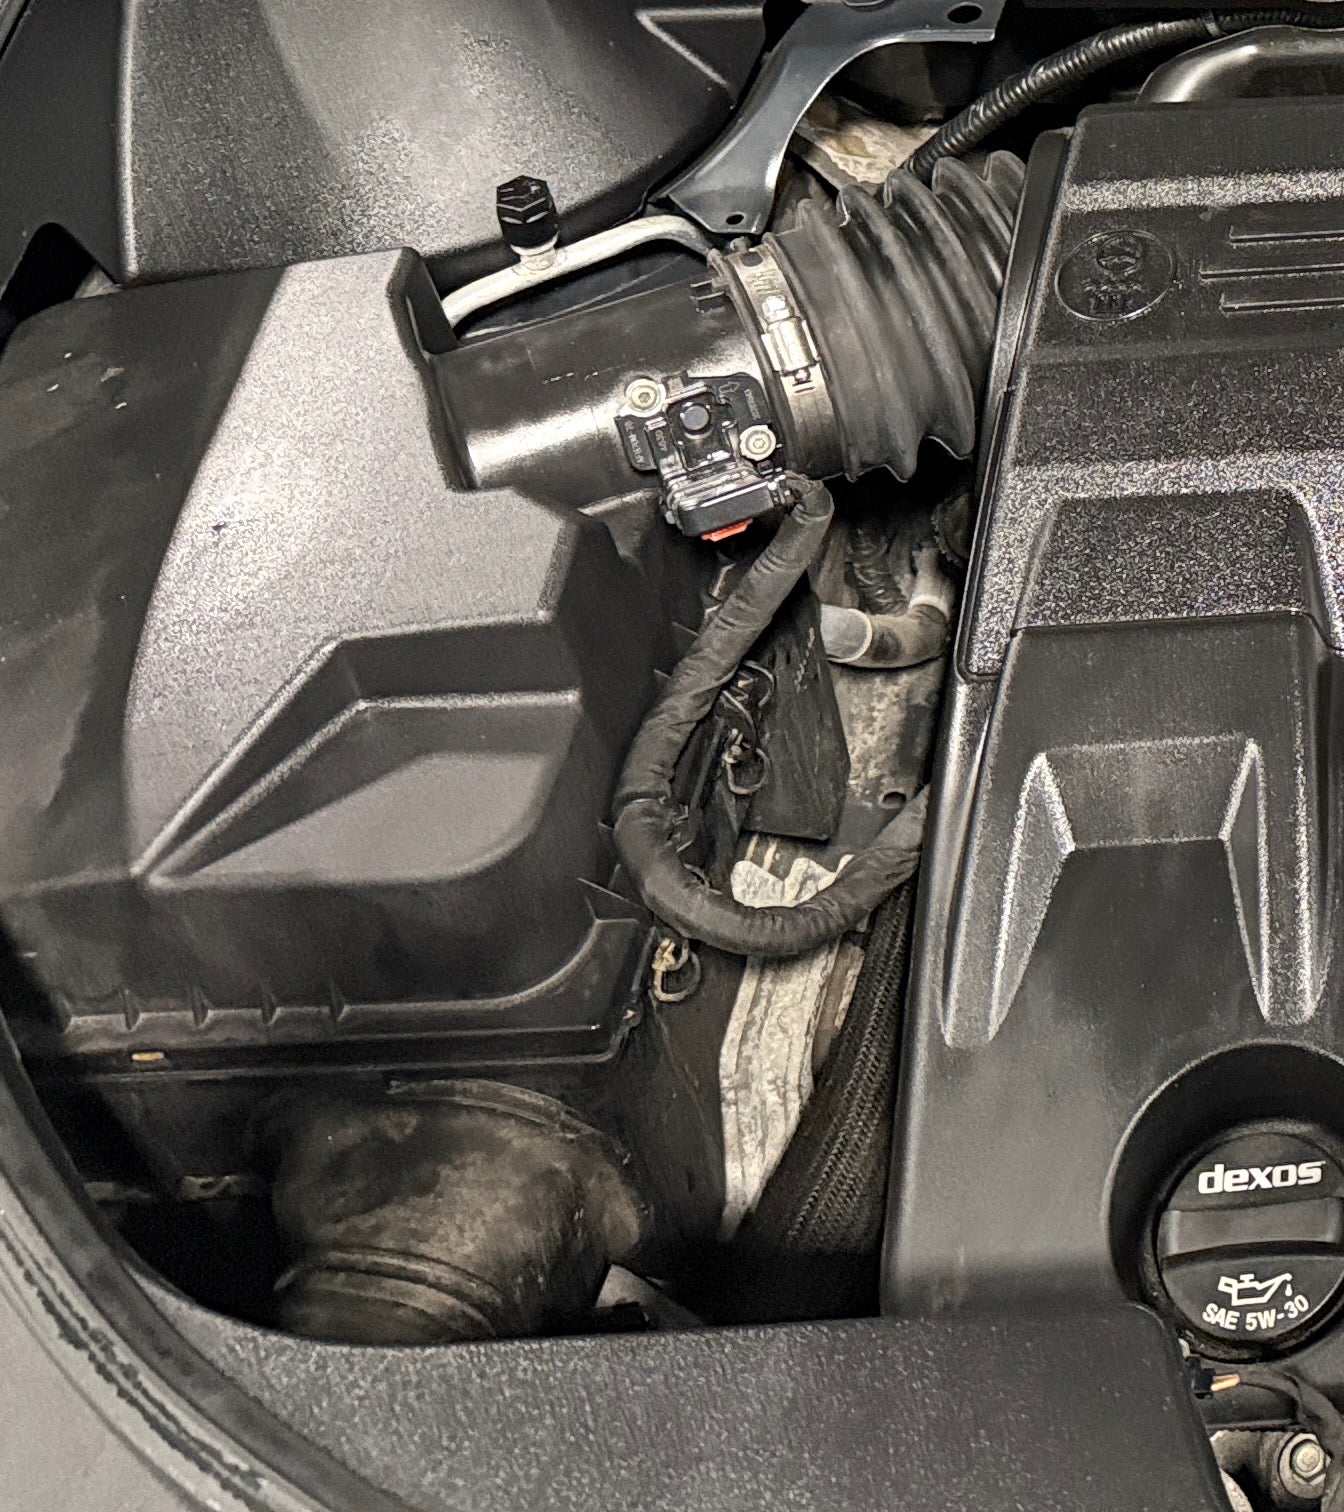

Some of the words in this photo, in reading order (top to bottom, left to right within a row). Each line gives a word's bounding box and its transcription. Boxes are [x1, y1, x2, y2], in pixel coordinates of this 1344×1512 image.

[1197, 1161, 1325, 1195] dexos
[1202, 1302, 1240, 1331] SAE
[1245, 1294, 1310, 1332] 5W-30
